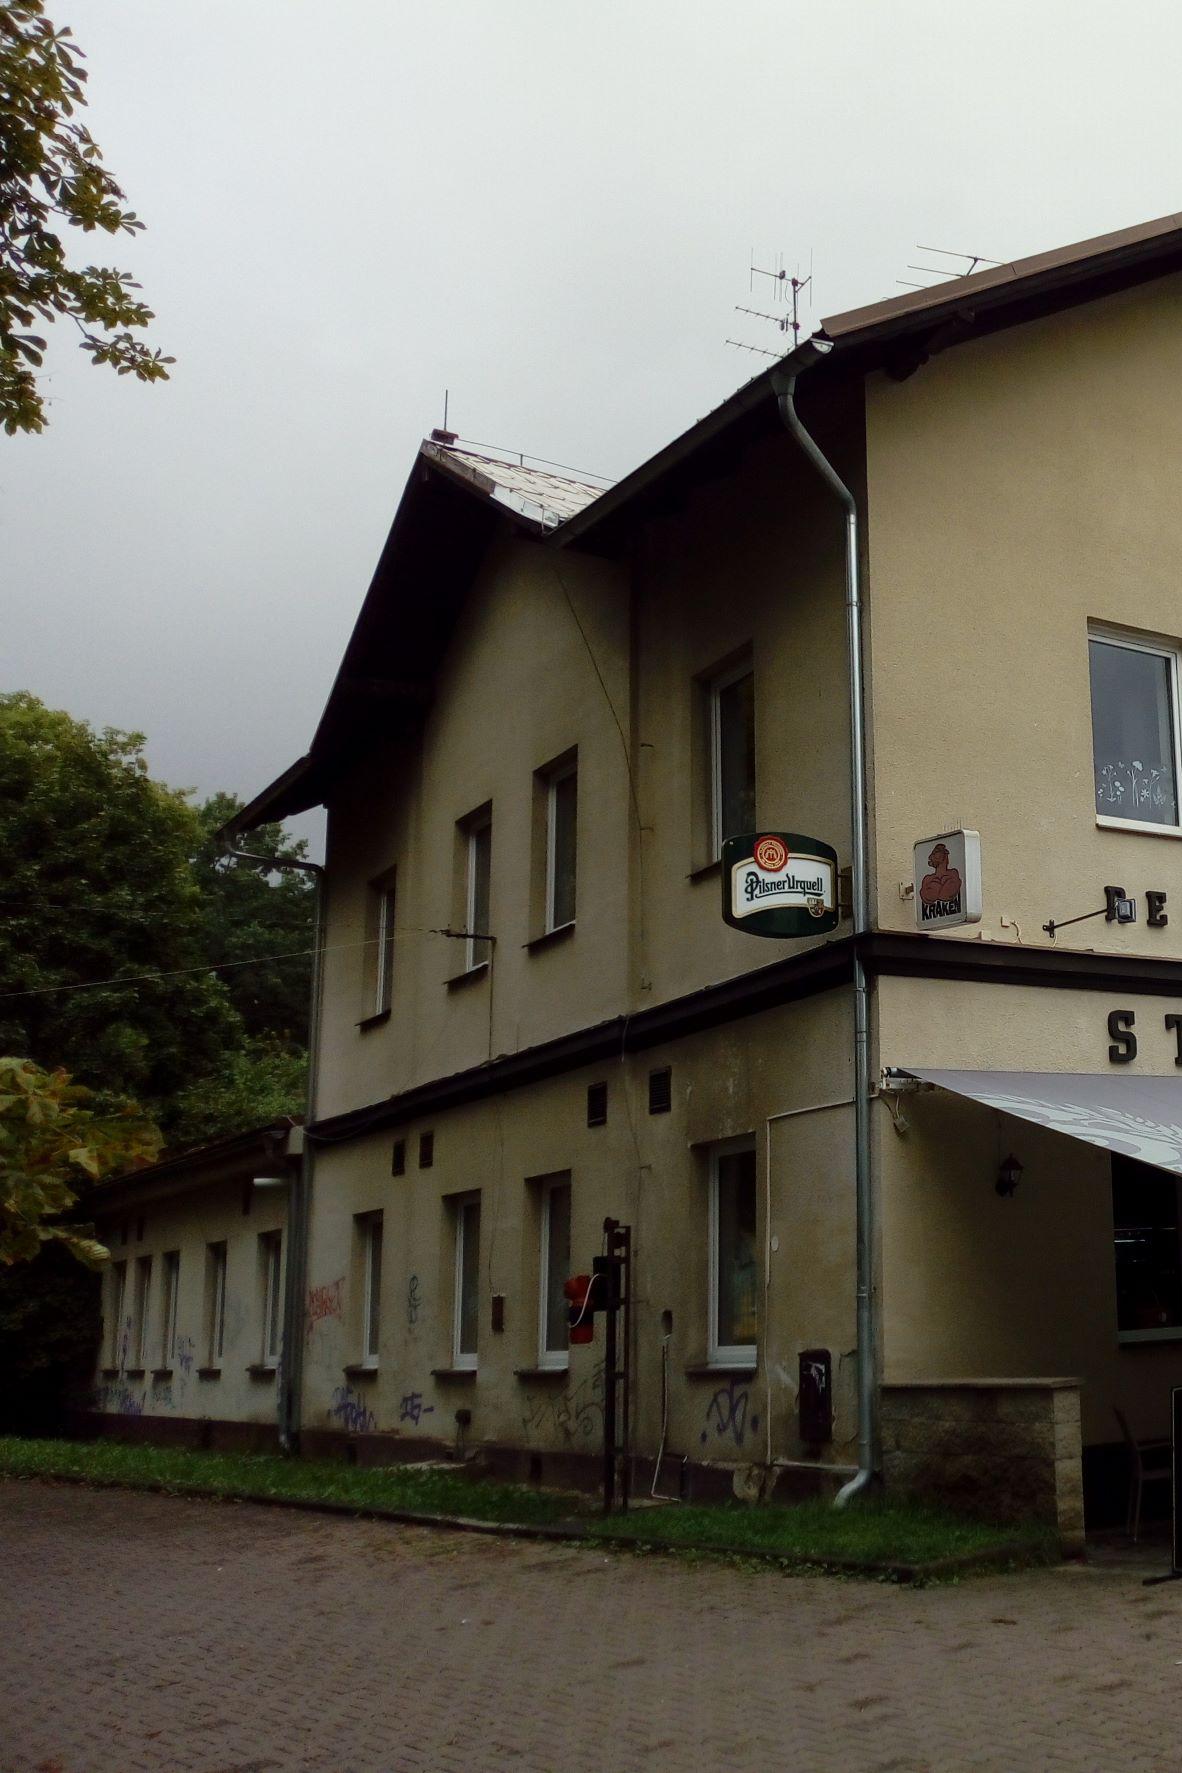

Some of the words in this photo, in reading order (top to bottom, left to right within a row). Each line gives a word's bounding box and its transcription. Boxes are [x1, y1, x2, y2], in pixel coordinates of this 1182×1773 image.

[744, 871, 787, 902] Pilsner
[786, 873, 823, 897] Urquell
[921, 892, 961, 921] KRAKEN
